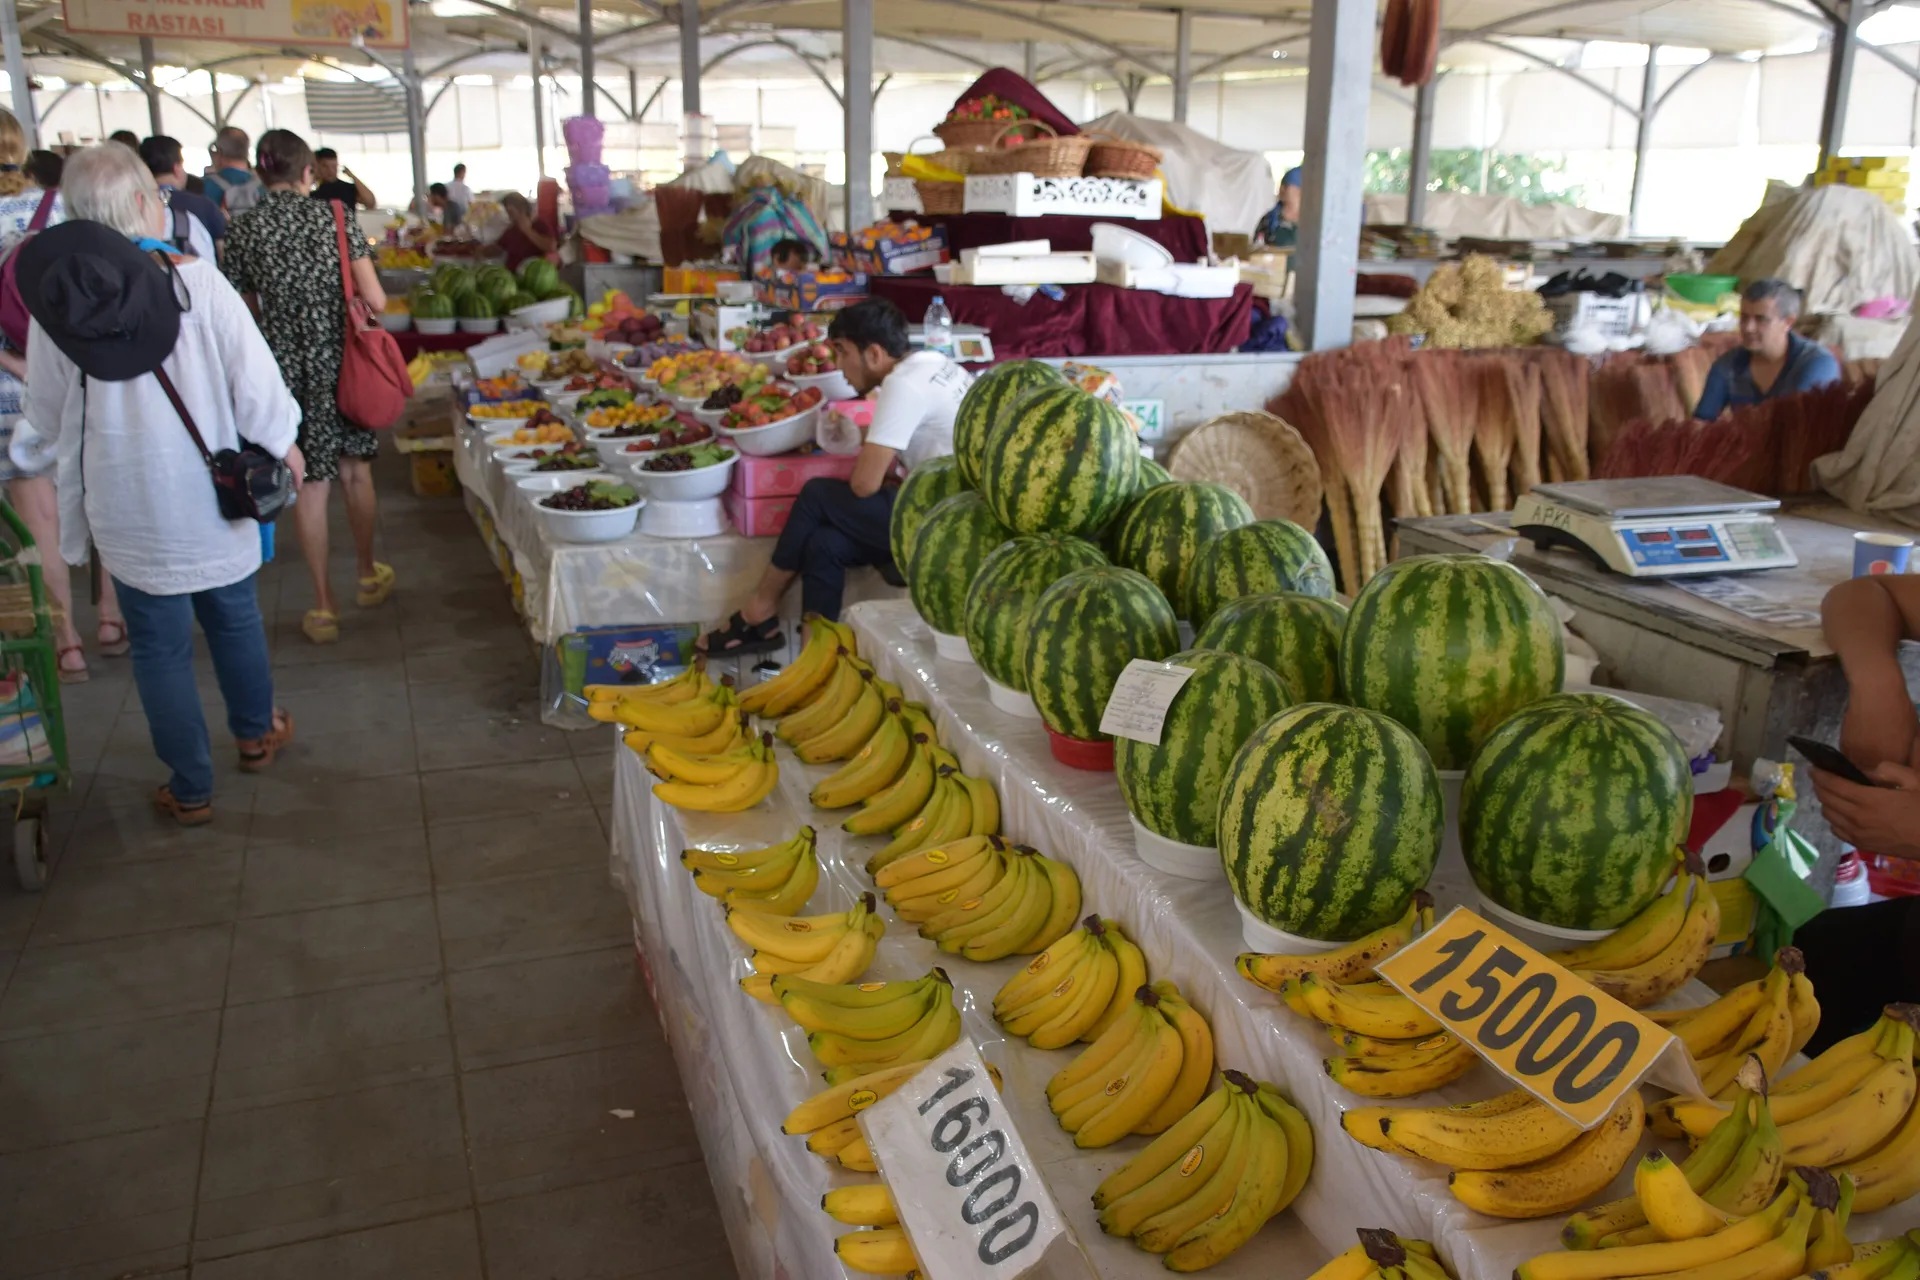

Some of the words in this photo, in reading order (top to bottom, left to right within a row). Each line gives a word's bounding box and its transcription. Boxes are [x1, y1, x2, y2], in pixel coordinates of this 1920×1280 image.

[127, 12, 225, 35] RASTASI
[1409, 930, 1640, 1104] 15000
[917, 1066, 1039, 1265] 16000
